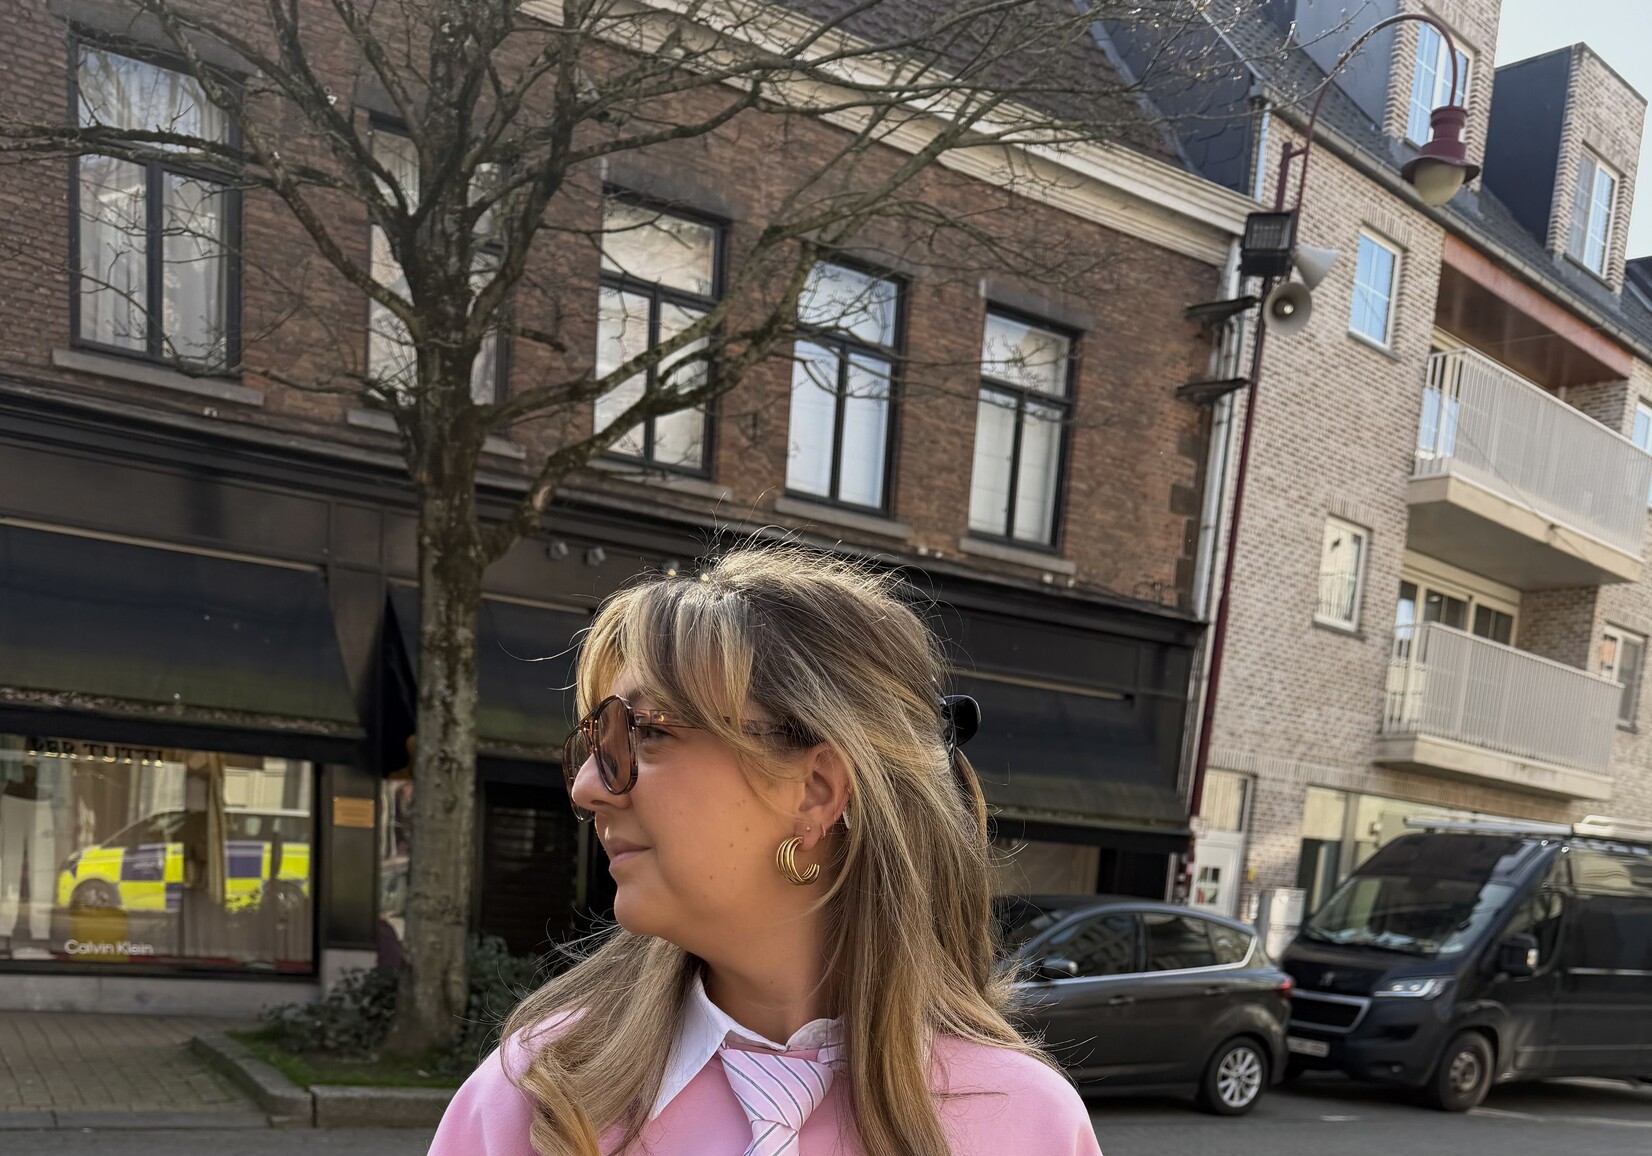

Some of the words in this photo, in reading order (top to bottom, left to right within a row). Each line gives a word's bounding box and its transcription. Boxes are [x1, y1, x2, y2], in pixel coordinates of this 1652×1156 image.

[83, 743, 163, 767] TUTTI
[64, 939, 115, 955] Calvin
[116, 941, 154, 956] Klein
